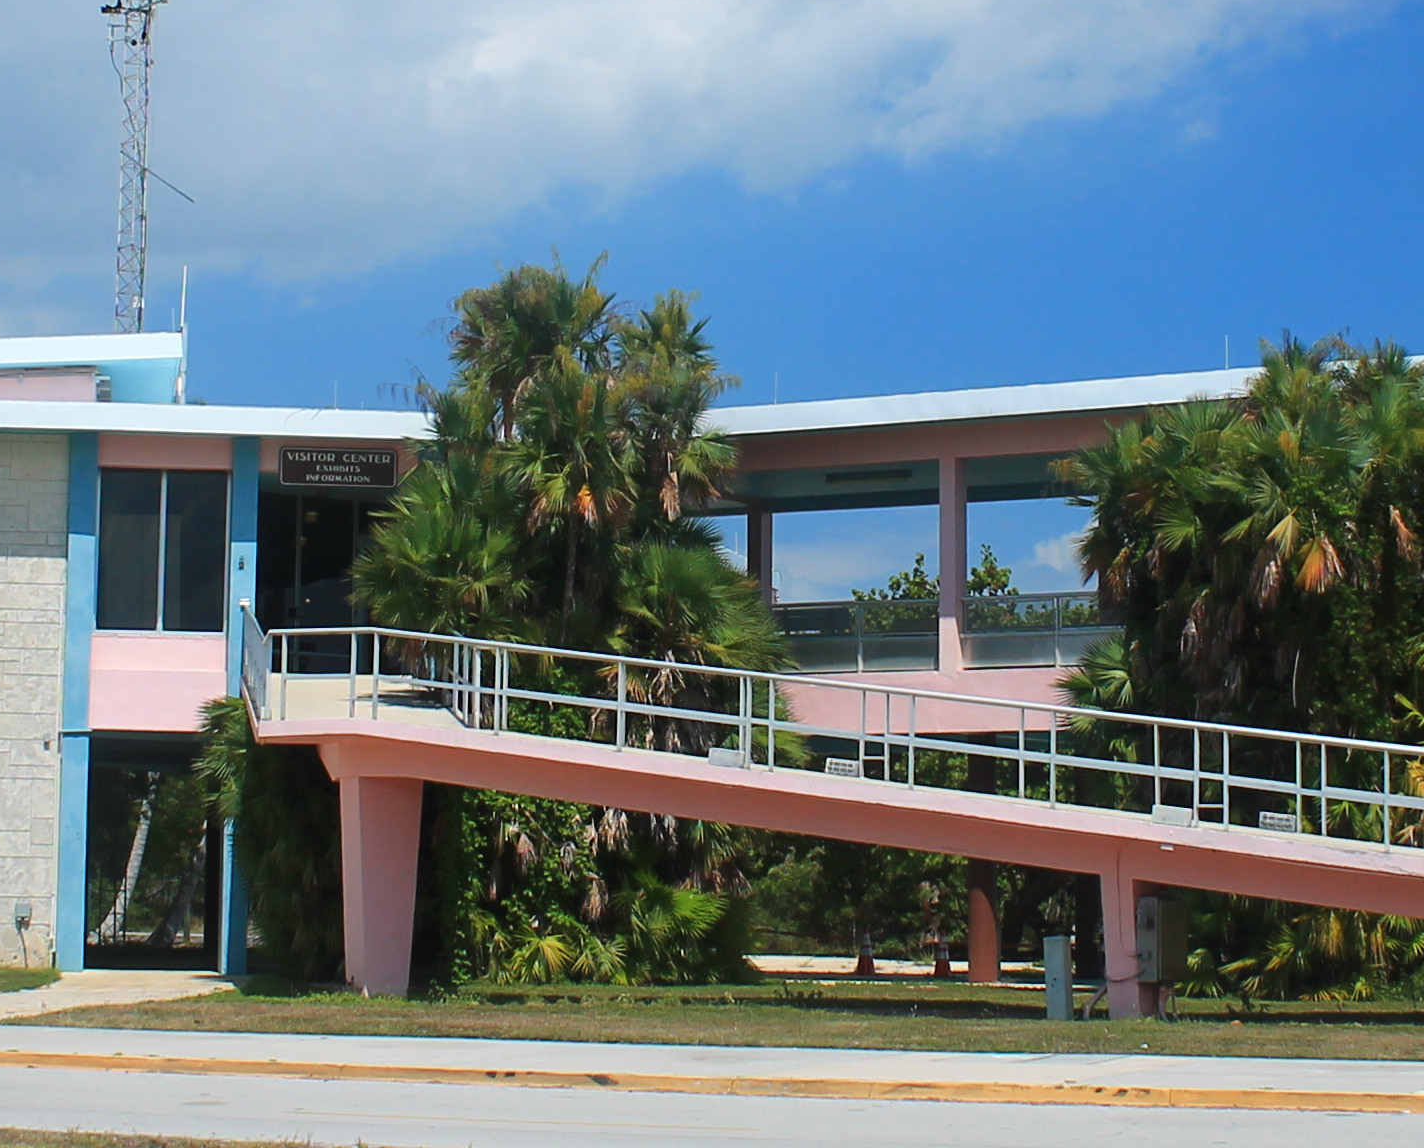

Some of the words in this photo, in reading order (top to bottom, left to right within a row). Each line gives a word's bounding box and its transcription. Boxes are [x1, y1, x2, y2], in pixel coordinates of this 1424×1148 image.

[287, 452, 335, 462] VISITOR
[343, 453, 391, 463] CENTER
[316, 464, 360, 473] EXHIBITS
[306, 474, 370, 483] INFORMATION
